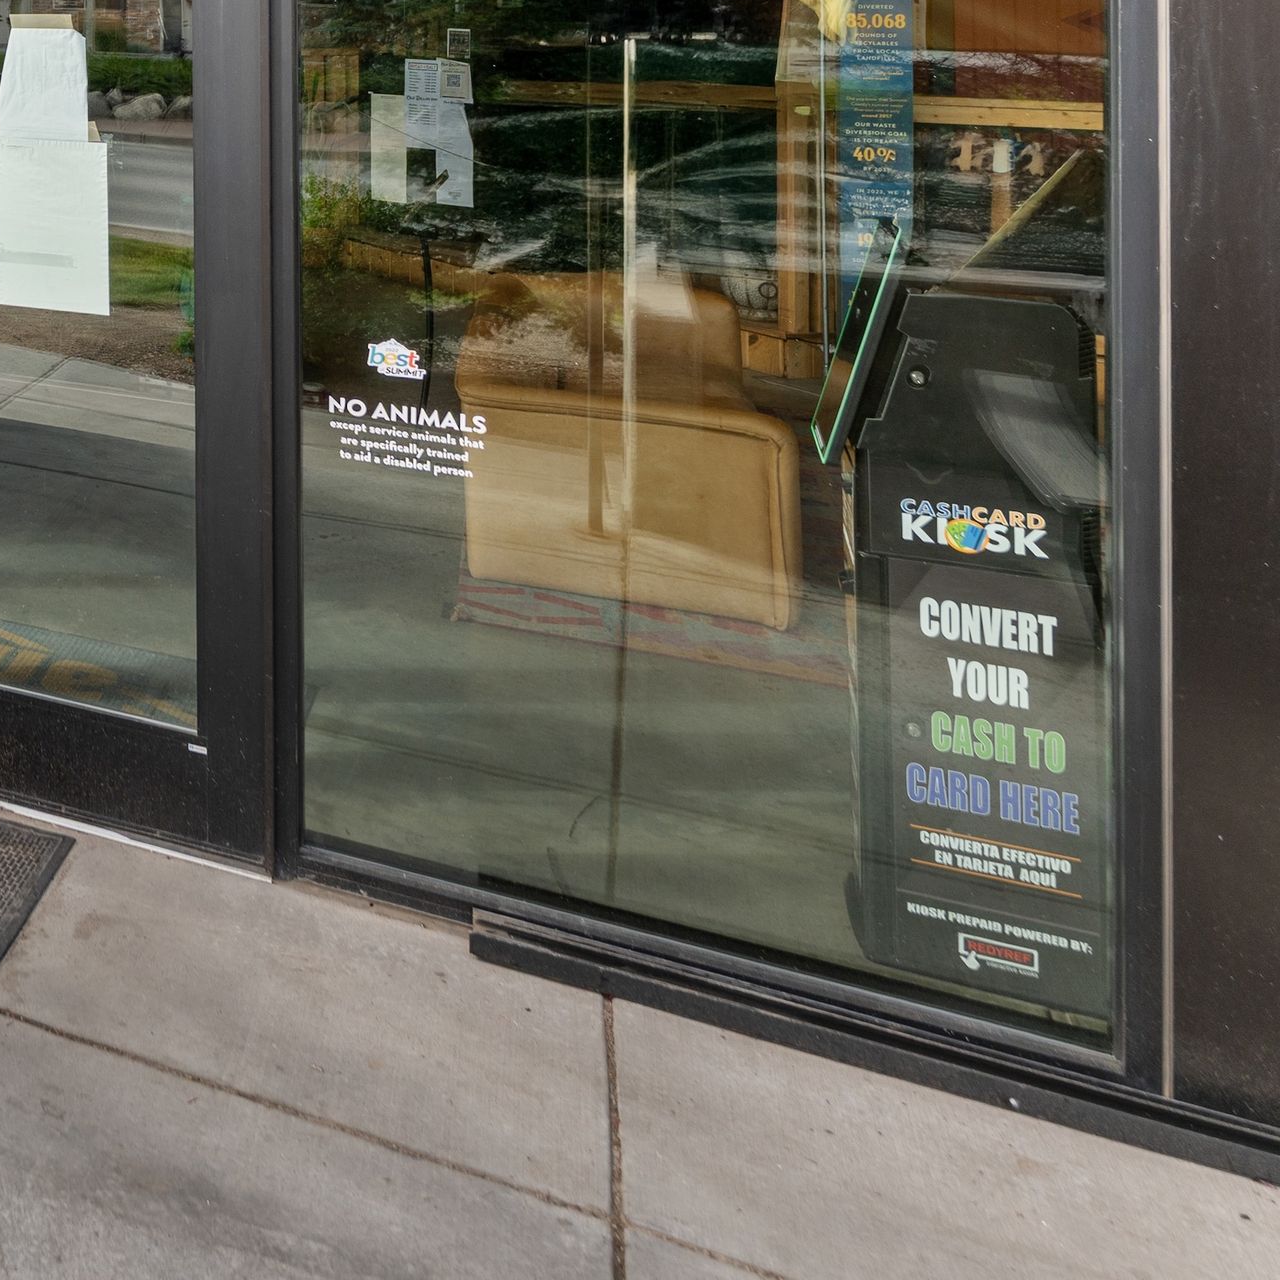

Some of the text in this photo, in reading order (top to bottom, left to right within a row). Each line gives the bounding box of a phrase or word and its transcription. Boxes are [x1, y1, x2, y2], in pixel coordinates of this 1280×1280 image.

[846, 12, 906, 29] 85,068
[852, 146, 897, 162] 40%
[369, 345, 418, 369] best
[385, 366, 425, 378] SUMMIT
[328, 395, 488, 434] NO ANIMALS
[329, 419, 485, 450] except service animals that
[340, 437, 469, 463] are specifically trained
[339, 449, 473, 479] to aid a disabled person
[900, 498, 1046, 530] CASHCARD
[919, 596, 1058, 657] CONVERT
[946, 657, 1030, 710] YOUR
[930, 710, 1067, 775] CASH TO
[905, 762, 1081, 836] CARD HERE
[919, 830, 1072, 875] CONVIERTA EFECTIVO
[934, 850, 954, 867] EN
[955, 853, 1015, 881] TARJETA
[907, 902, 1094, 956] KIOSK PREPAID POWERED BY:
[967, 940, 1033, 964] REDYREF
